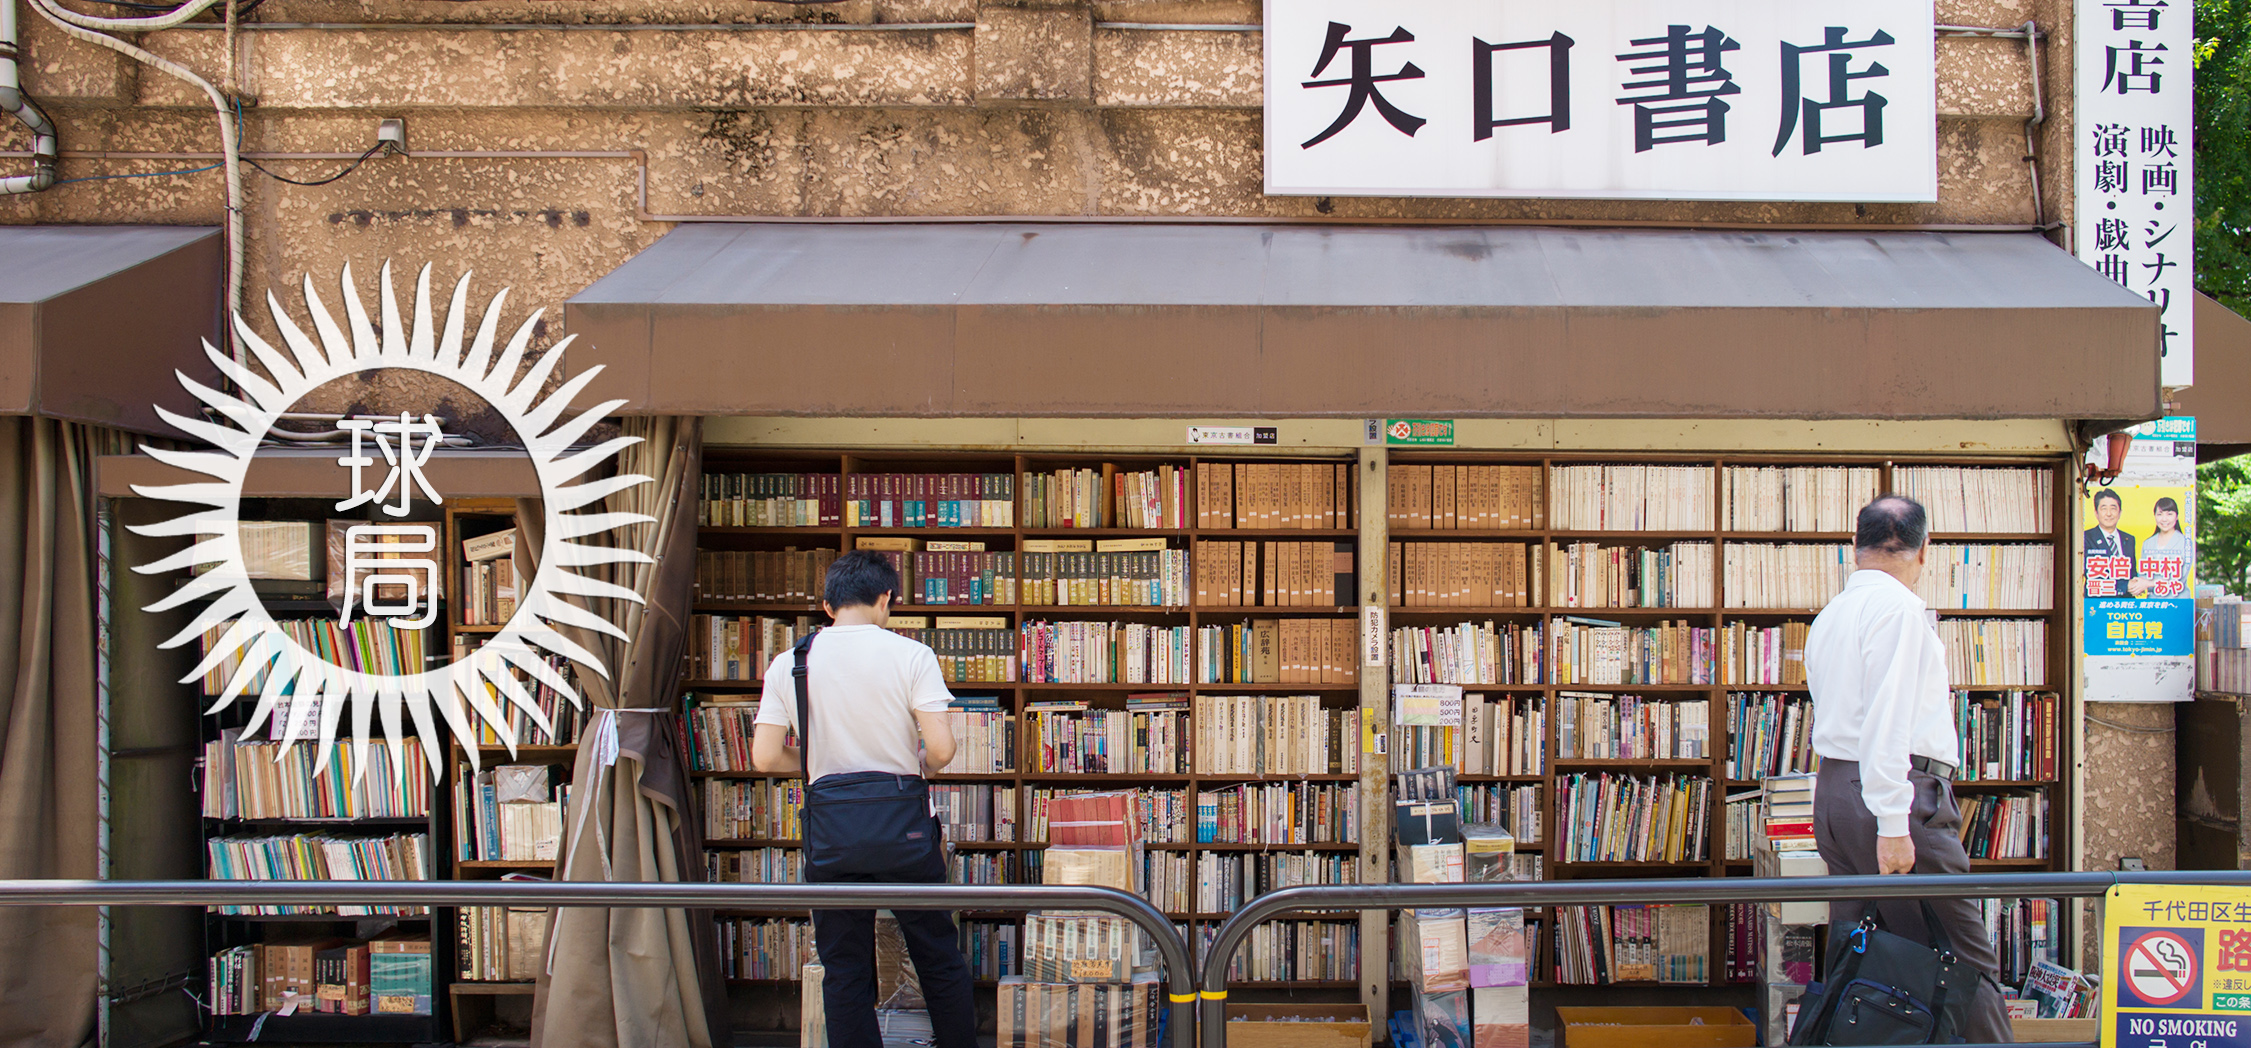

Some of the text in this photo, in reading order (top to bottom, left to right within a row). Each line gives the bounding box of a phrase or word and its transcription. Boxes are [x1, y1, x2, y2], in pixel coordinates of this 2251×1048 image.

[1301, 21, 1895, 158] 矢口書店
[1202, 431, 1276, 440] 東京古書組合 加盟店
[2087, 556, 2131, 579] 安倍
[2139, 556, 2183, 579] 中村
[2087, 580, 2117, 596] 晋三
[2154, 580, 2184, 596] あや
[2107, 612, 2143, 621] TOKYO
[1370, 611, 1379, 661] 防犯カメラ設置
[2106, 621, 2163, 639] 自民党
[1260, 630, 1270, 655] 広辞苑
[1439, 699, 1461, 707] 800円
[1439, 708, 1461, 716] 500円
[1439, 717, 1461, 725] 200円
[2143, 900, 2251, 923] 千代田区生
[2216, 928, 2251, 973] 路
[2129, 1018, 2238, 1037] NO SMOKING
